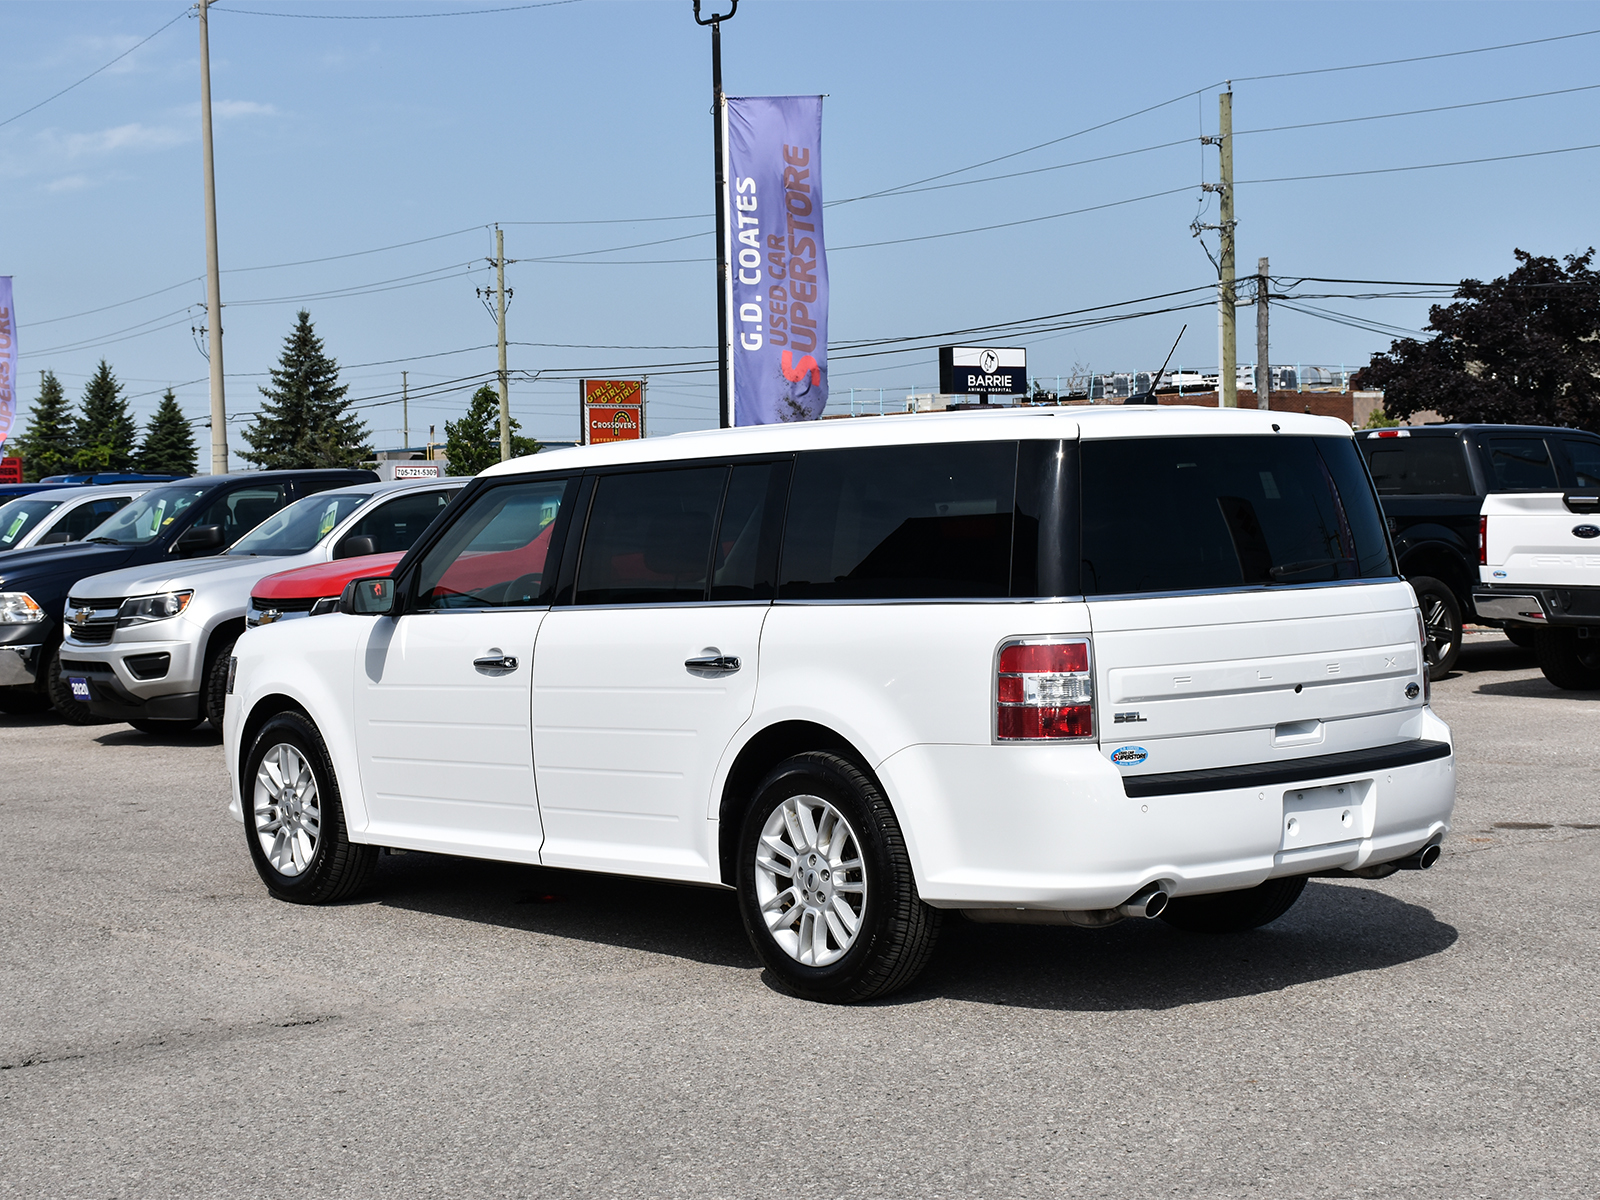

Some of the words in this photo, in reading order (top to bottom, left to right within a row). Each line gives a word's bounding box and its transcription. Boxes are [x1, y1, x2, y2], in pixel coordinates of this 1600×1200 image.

[736, 176, 761, 285] COATES
[767, 233, 786, 280] CAR
[781, 144, 820, 387] SUPERSTORE
[740, 295, 763, 351] G.D.
[769, 284, 788, 346] USED
[587, 381, 612, 403] GIRLS
[601, 381, 626, 403] GIRLS
[615, 381, 640, 403] GIRLS
[967, 375, 1012, 387] BARRIE
[591, 420, 637, 429] CROSSOVER'S
[1173, 656, 1396, 688] FLEX
[71, 683, 89, 695] 2020
[1113, 711, 1148, 723] SEL
